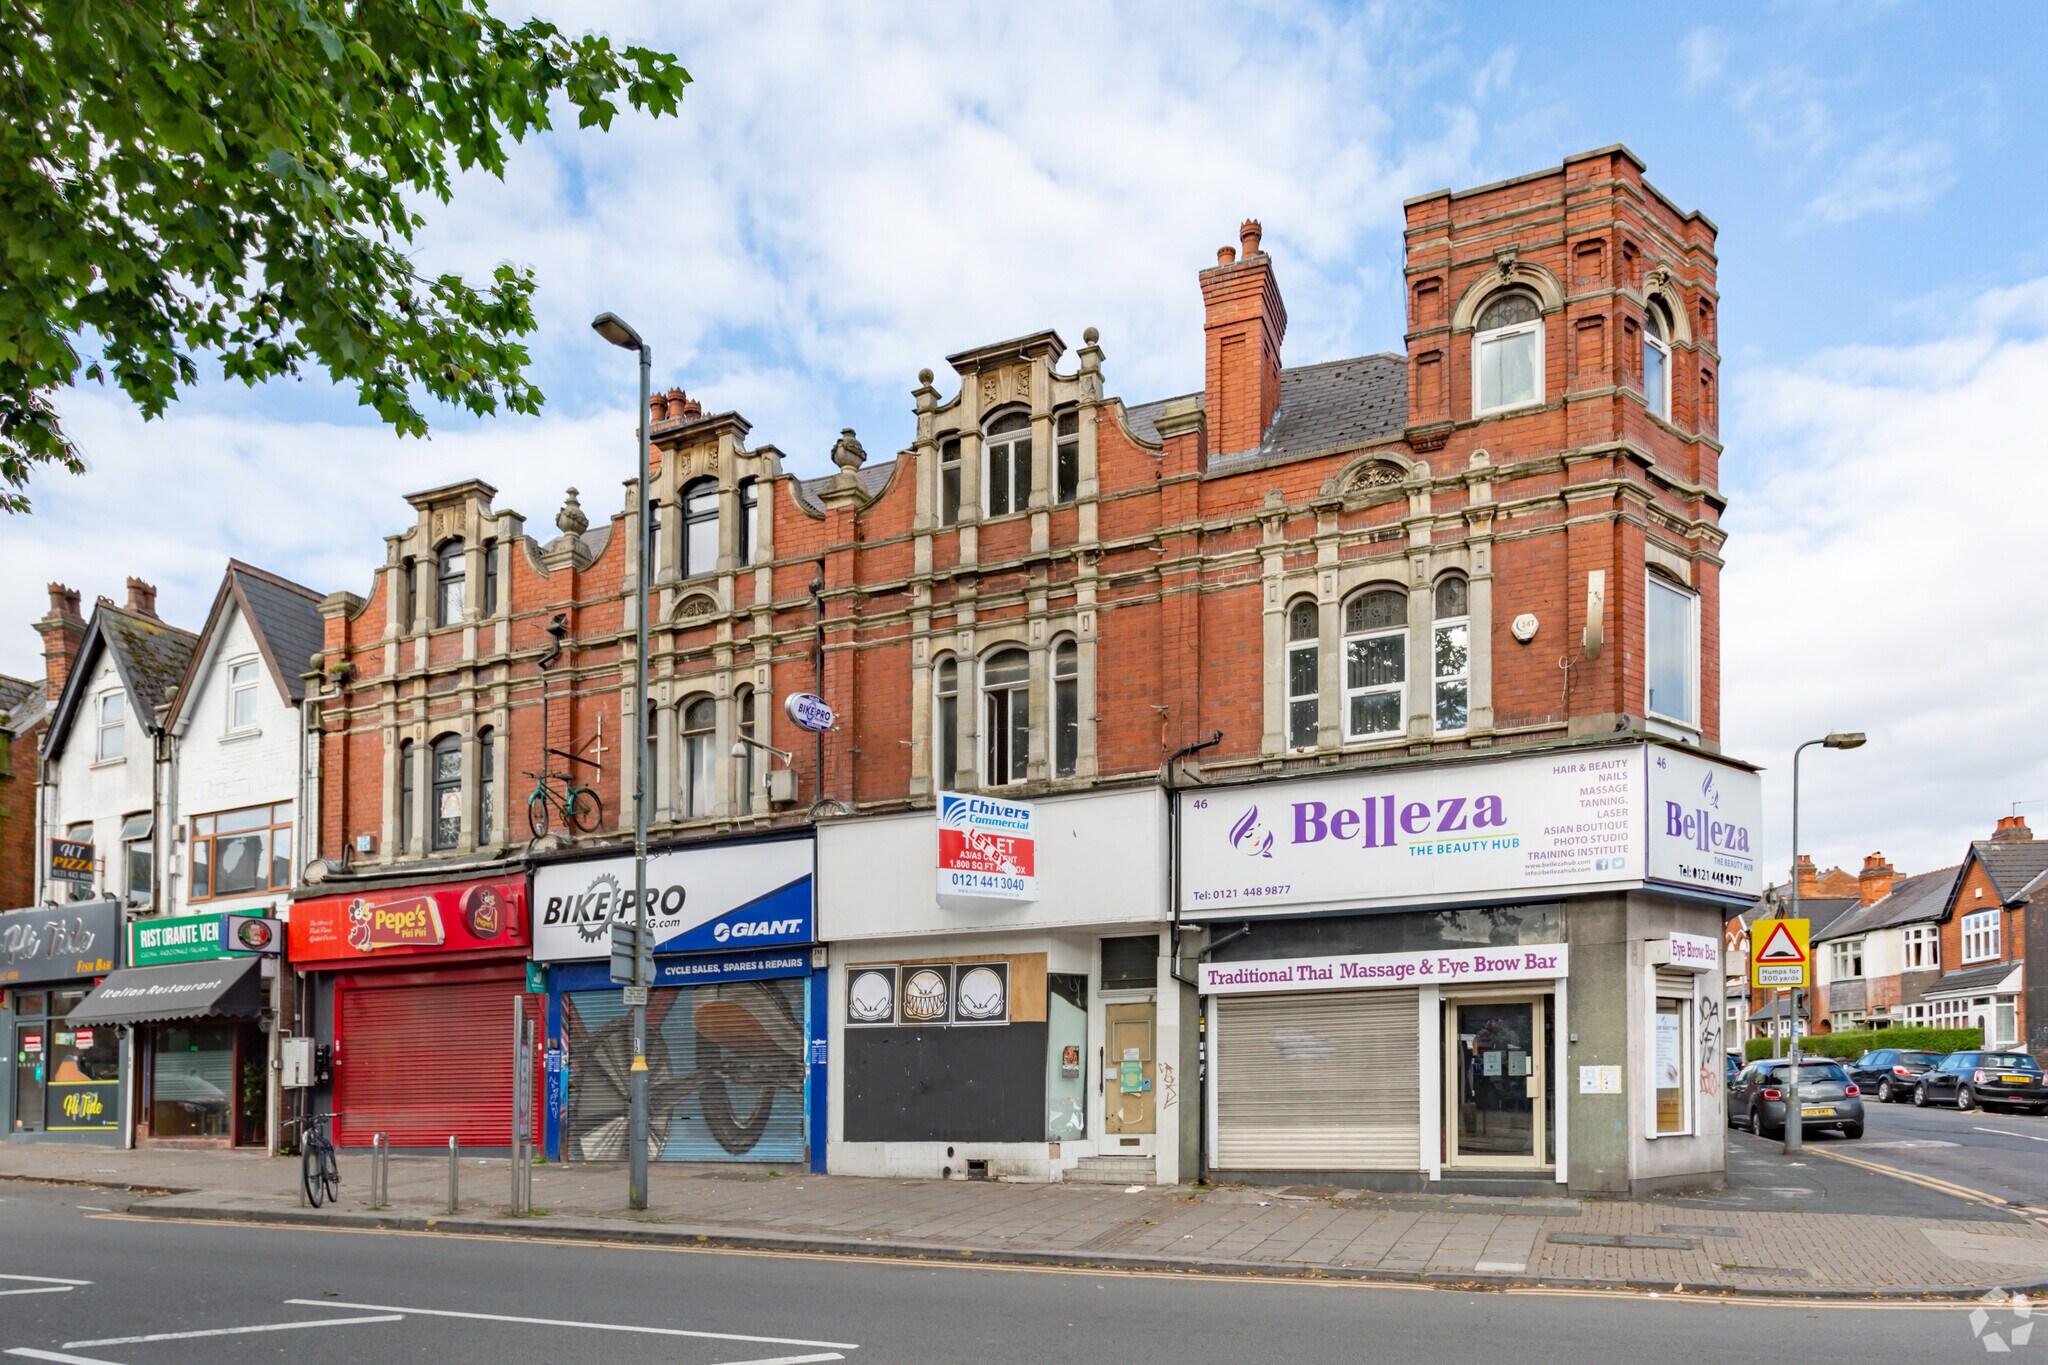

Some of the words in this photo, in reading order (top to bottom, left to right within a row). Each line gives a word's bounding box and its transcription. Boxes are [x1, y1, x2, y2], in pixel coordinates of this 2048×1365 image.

[798, 703, 815, 716] BIKE
[815, 708, 831, 721] PRO
[1553, 764, 1577, 775] HAIR
[1579, 763, 1587, 772] &
[1588, 759, 1628, 771] BEAUTY
[1656, 756, 1667, 769] 46
[1598, 771, 1628, 782] NAILS
[1579, 783, 1628, 796] MASSAGE
[969, 799, 1031, 820] Chivers
[1193, 799, 1208, 810] 46
[1291, 794, 1508, 849] Belleza
[1597, 808, 1628, 819] LASER
[969, 814, 1029, 830] Commercial
[1543, 825, 1575, 836] ASIAN
[1576, 820, 1629, 833] BOUTIQUE
[1665, 800, 1750, 853] Belleza
[969, 828, 991, 851] LET
[991, 850, 1007, 865] BY
[1409, 845, 1434, 857] THE
[1436, 840, 1488, 855] BEAUTY
[1492, 838, 1520, 850] HUB
[1553, 835, 1588, 847] PHOTO
[1590, 832, 1629, 844] STUDIO
[960, 851, 982, 860] A3/A5
[1528, 849, 1575, 861] TRAINING
[1577, 844, 1629, 857] INSTITUTE
[52, 856, 94, 872] PIZZA
[949, 860, 970, 869] 1,800
[972, 862, 983, 870] SQ
[985, 863, 994, 871] FT
[1525, 860, 1591, 869] www.bellezahub.com
[1714, 856, 1724, 867] THE
[1724, 858, 1743, 869] BEAUTY
[952, 873, 978, 886] 0121
[980, 875, 998, 888] 441
[1001, 878, 1025, 891] 3040
[1679, 864, 1692, 879] Tel:
[1692, 867, 1710, 881] 0121
[1711, 871, 1724, 884] 448
[1726, 874, 1743, 887] 9877
[1193, 890, 1211, 900] Tel:
[1212, 888, 1238, 899] 0121
[1243, 887, 1262, 897] 448
[1265, 885, 1291, 896] 9877
[543, 892, 612, 925] BIKE
[618, 885, 686, 919] PRO
[375, 904, 426, 934] Pepe's
[401, 930, 414, 938] Piri
[414, 928, 427, 937] Piri
[731, 919, 803, 938] GIANT
[1672, 940, 1686, 960] Eye
[1687, 942, 1704, 959] Brow
[1705, 944, 1717, 961] Bar
[665, 966, 691, 976] CYCLE
[692, 964, 721, 974] SALES,
[723, 962, 757, 972] SPARES
[758, 962, 764, 970] &
[765, 958, 803, 969] REPAIRS
[1208, 966, 1294, 986] Traditional
[1296, 964, 1334, 982] Thai
[1340, 961, 1415, 981] Massage
[1419, 958, 1434, 975] &
[1437, 957, 1470, 978] Eye
[1474, 955, 1521, 972] Brow
[1524, 953, 1557, 970] Bar
[1761, 968, 1787, 976] Humps
[100, 987, 146, 999] Italian
[146, 979, 222, 995] Restaurant
